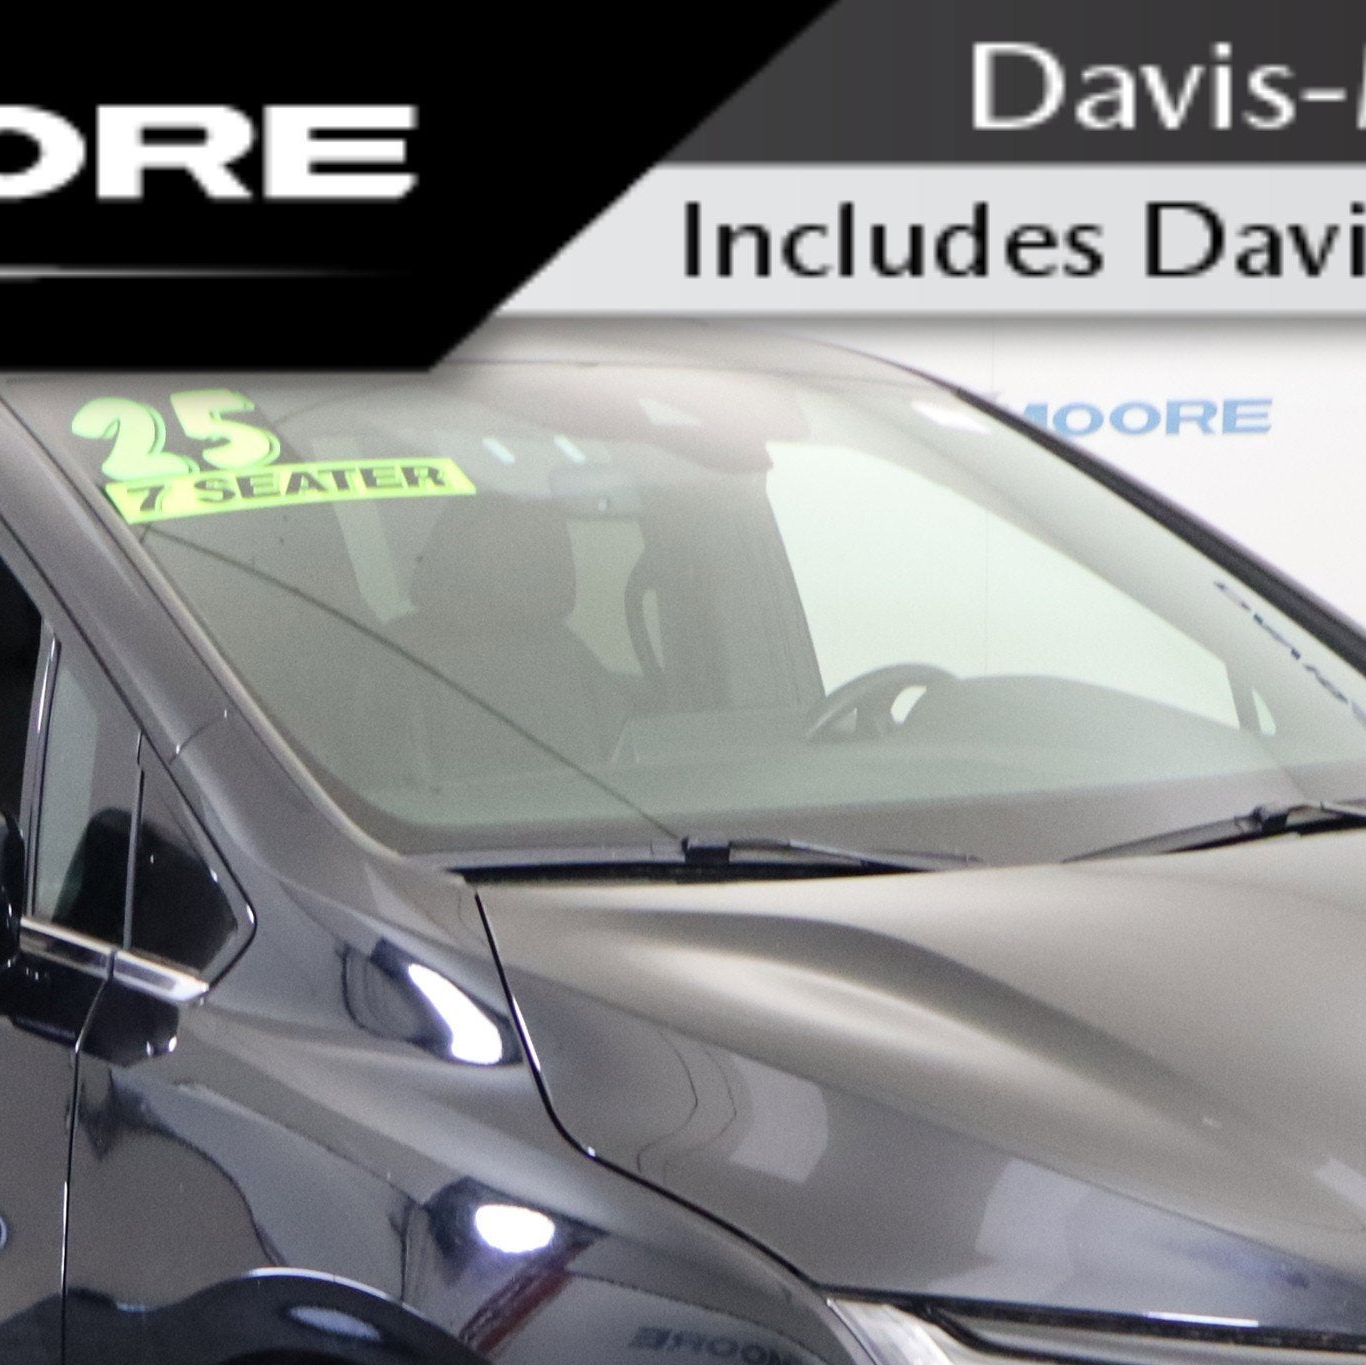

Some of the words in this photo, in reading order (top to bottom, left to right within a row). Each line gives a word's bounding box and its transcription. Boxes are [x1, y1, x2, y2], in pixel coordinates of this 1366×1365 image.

[71, 388, 281, 482] 25
[126, 484, 165, 512] 7
[193, 464, 446, 503] SEATER
